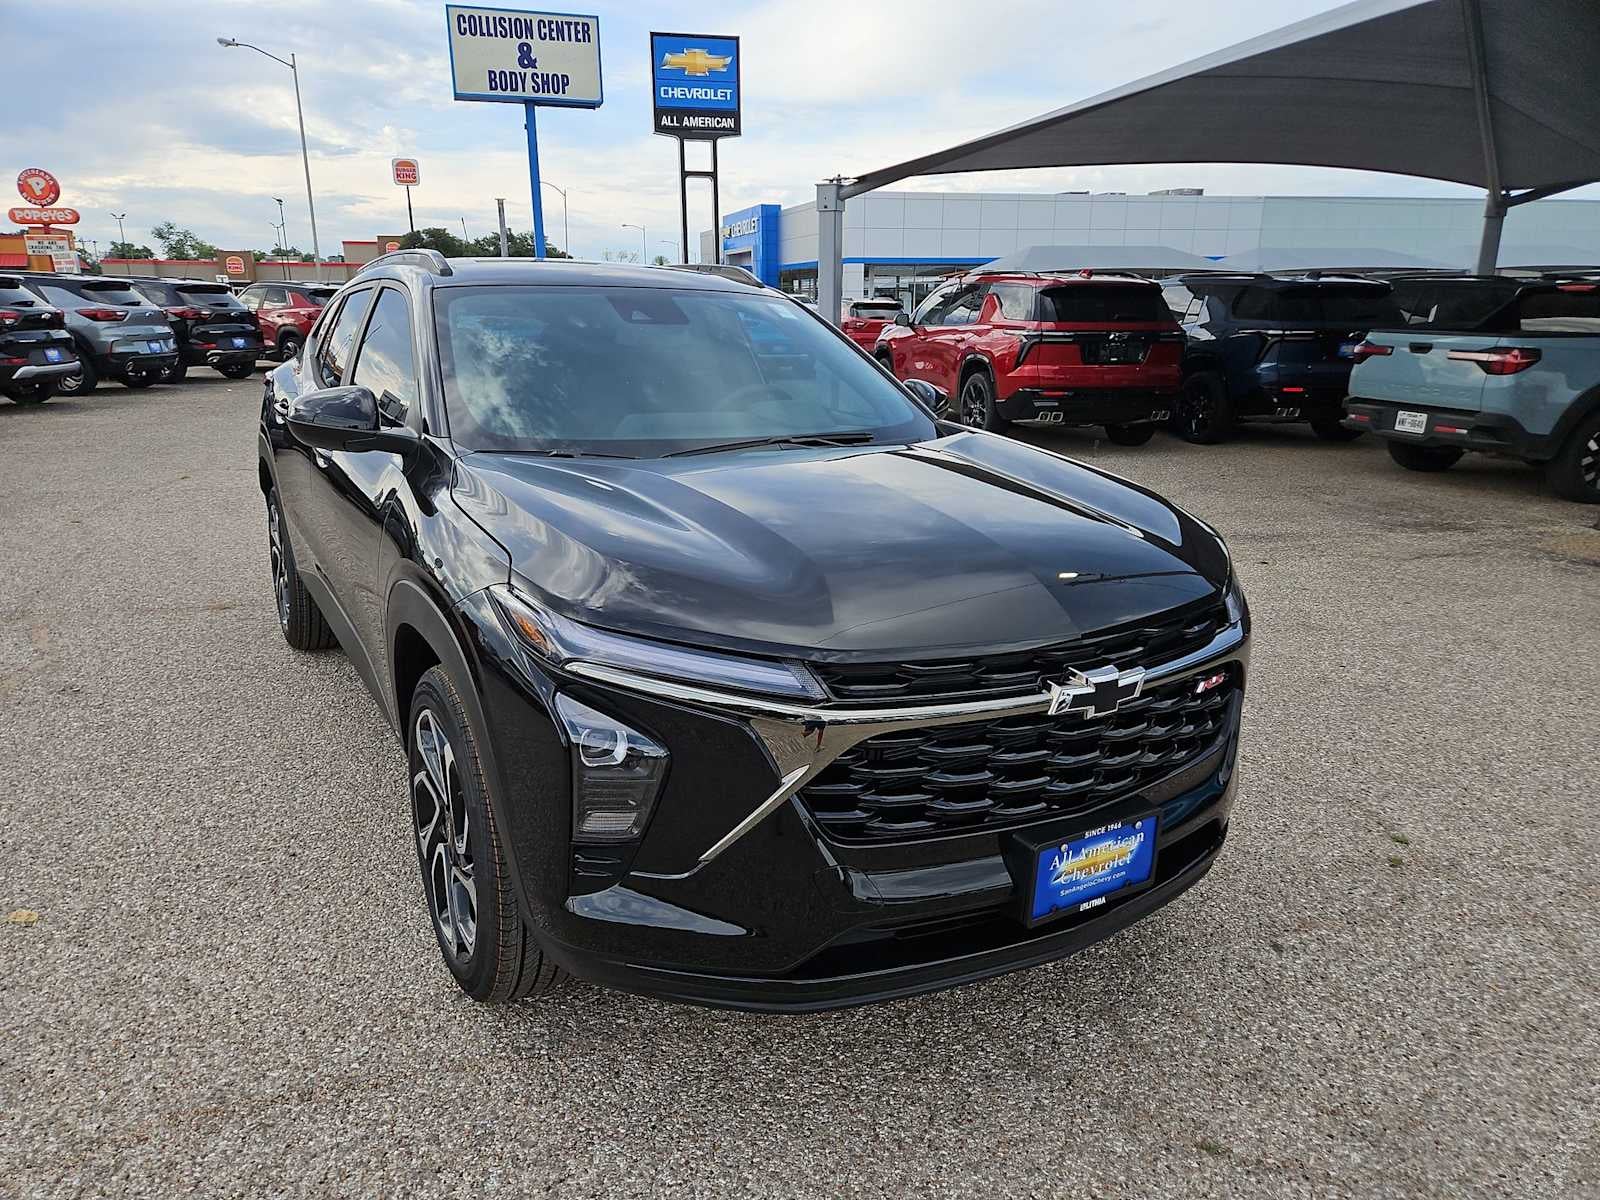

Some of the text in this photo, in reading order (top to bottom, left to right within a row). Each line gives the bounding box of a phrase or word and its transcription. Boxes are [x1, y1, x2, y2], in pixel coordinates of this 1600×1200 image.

[456, 14, 591, 43] COLLISION CENTER
[517, 42, 538, 69] &
[488, 70, 570, 95] BODY SHOP
[660, 86, 733, 101] CHEVROLET
[661, 115, 735, 129] ALL AMERICAN
[396, 172, 417, 180] KING
[13, 208, 73, 222] POPeYeS
[1084, 821, 1122, 839] SINCE 1946
[1050, 832, 1144, 870] All American
[1061, 852, 1131, 884] Chevrolet
